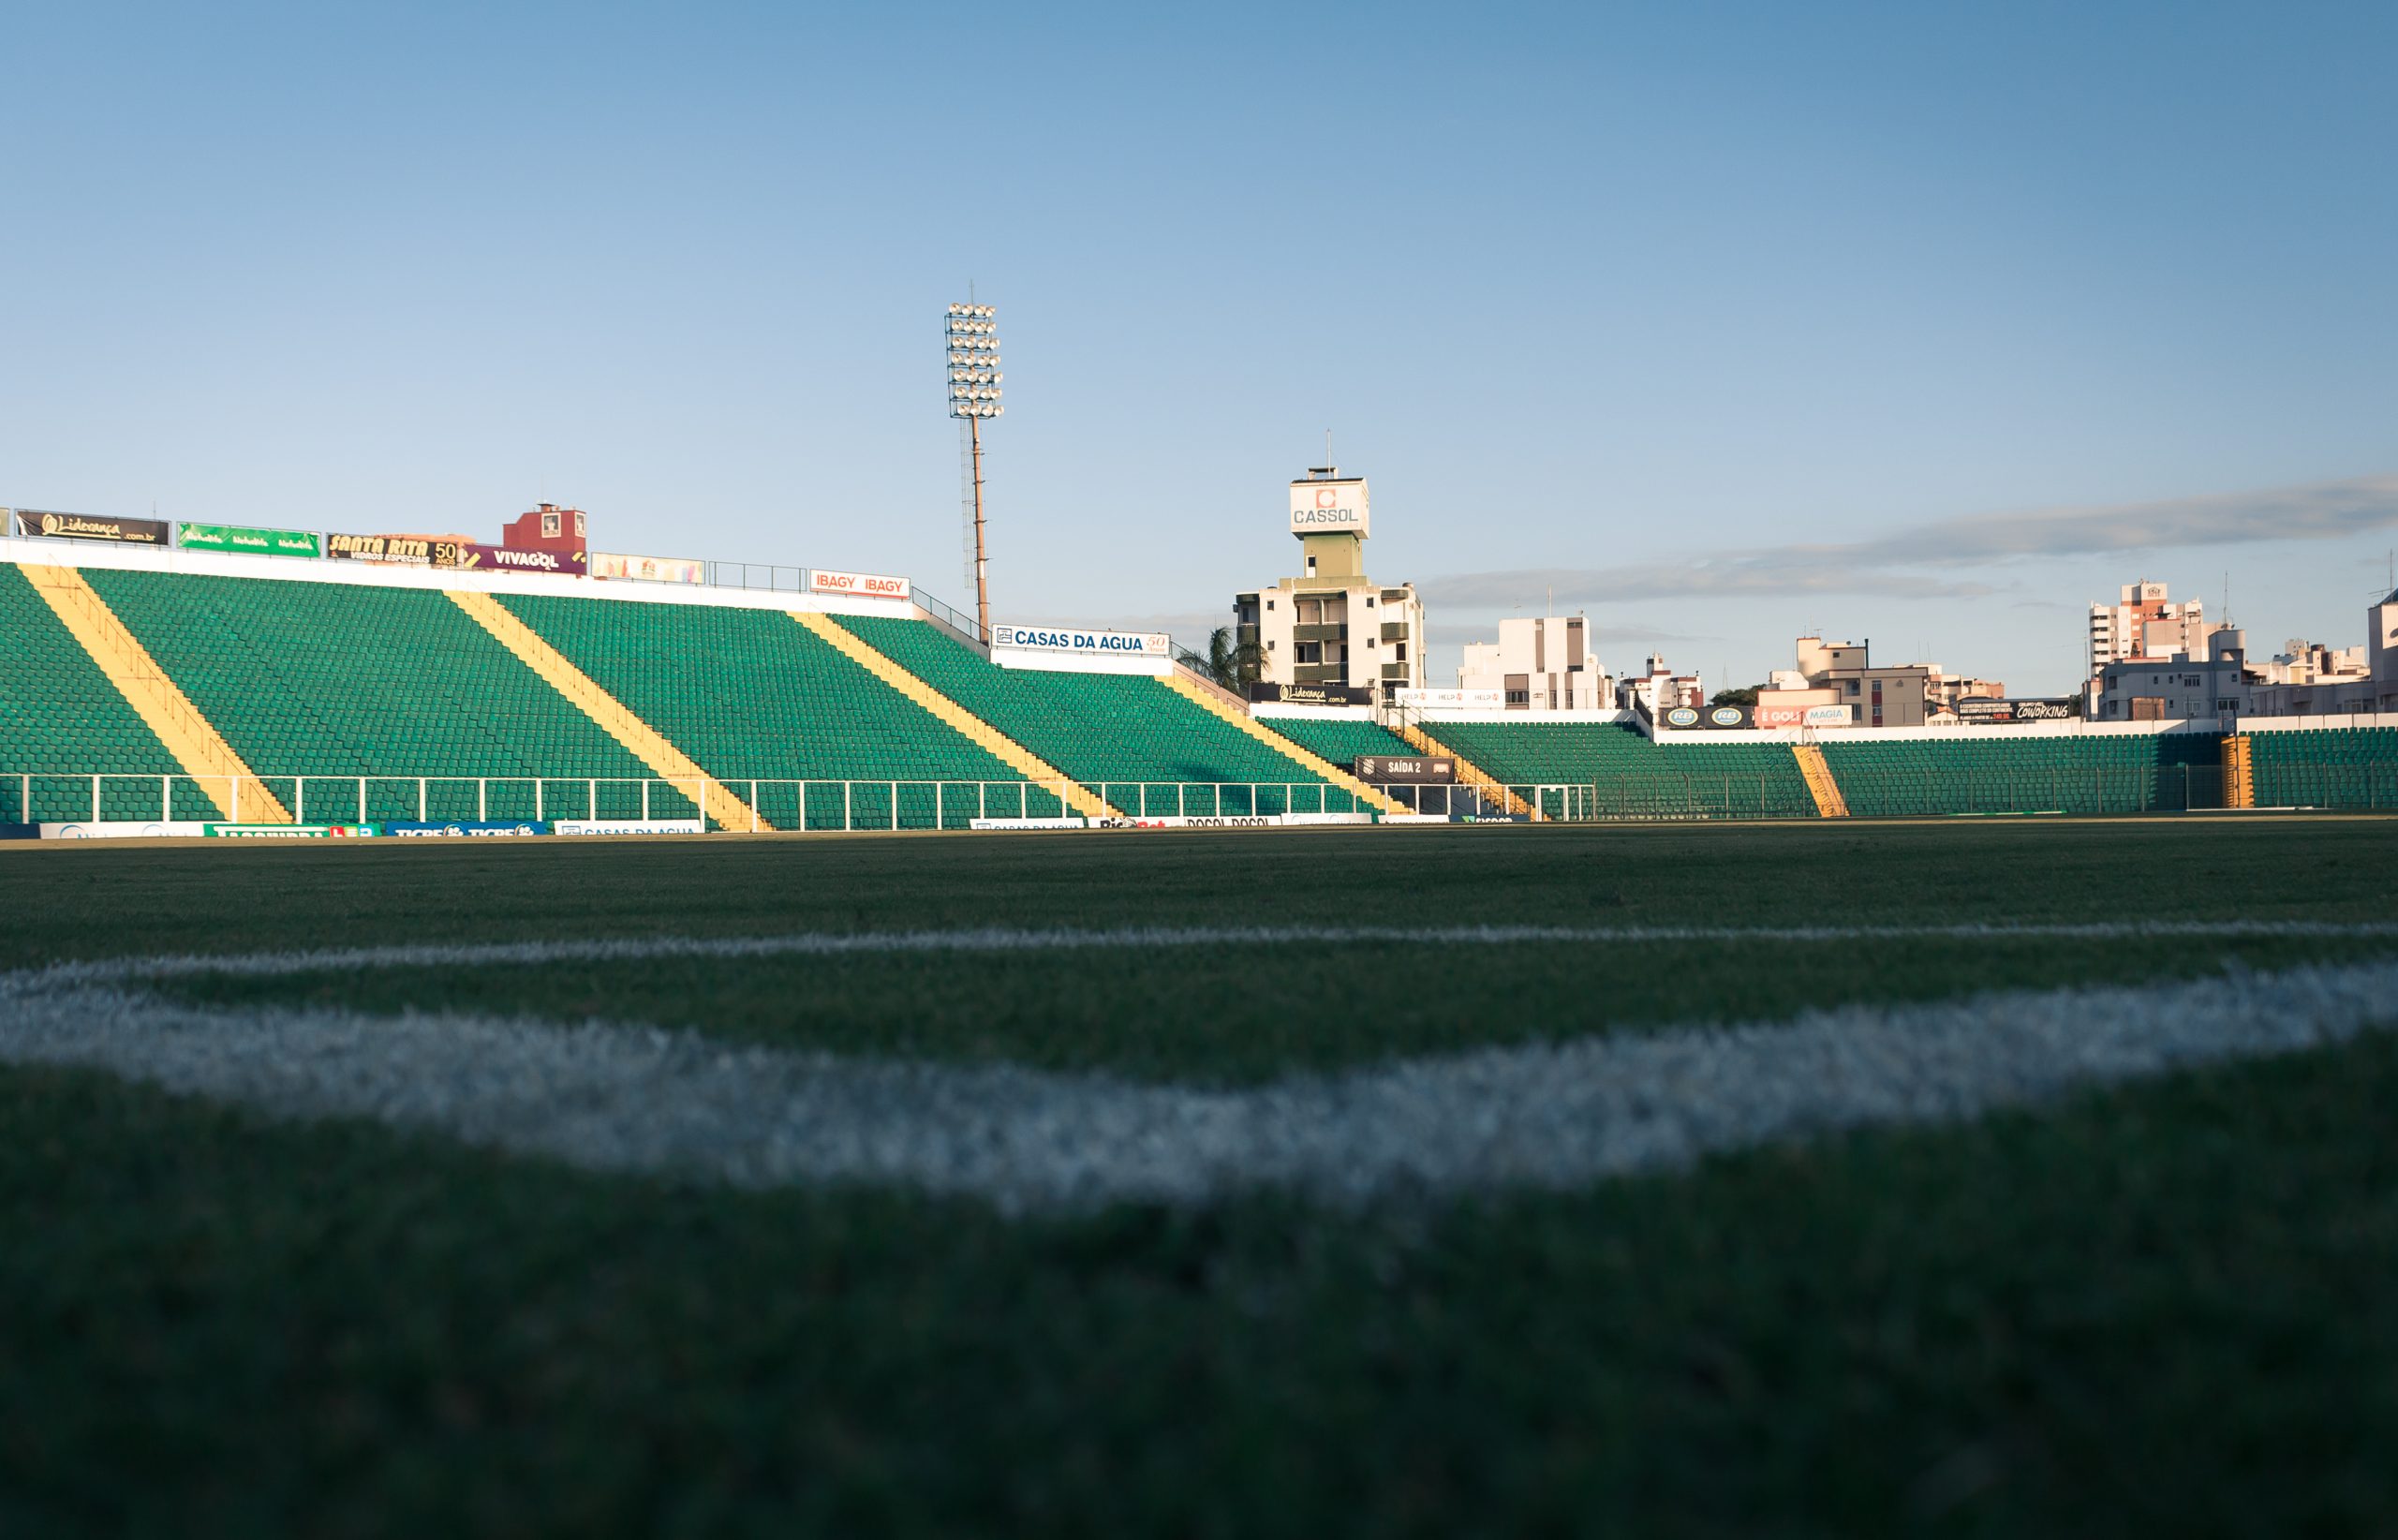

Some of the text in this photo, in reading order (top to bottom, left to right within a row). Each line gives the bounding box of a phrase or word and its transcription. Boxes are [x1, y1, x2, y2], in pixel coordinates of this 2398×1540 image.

[1294, 509, 1358, 524] CASSOL
[58, 515, 155, 541] Liderança .com.br
[329, 535, 385, 554] SANTA
[387, 540, 428, 556] RITA
[435, 543, 456, 558] 50
[350, 551, 430, 564] VIDROS ESPECIAIS
[494, 551, 559, 569] VIVAGOL
[817, 573, 903, 592] IBAGY IBAGY
[1015, 630, 1143, 651] CASAS DA ÁGUA
[1147, 636, 1165, 646] 50
[1289, 686, 1325, 700] Liderança
[1674, 711, 1693, 719] RB
[1717, 711, 1737, 719] RB
[1761, 708, 1769, 722] É
[1810, 709, 1843, 719] MAGIA
[2017, 705, 2068, 718] COWORKING
[1388, 760, 1414, 773] SAÍDA
[1415, 763, 1421, 774] 2
